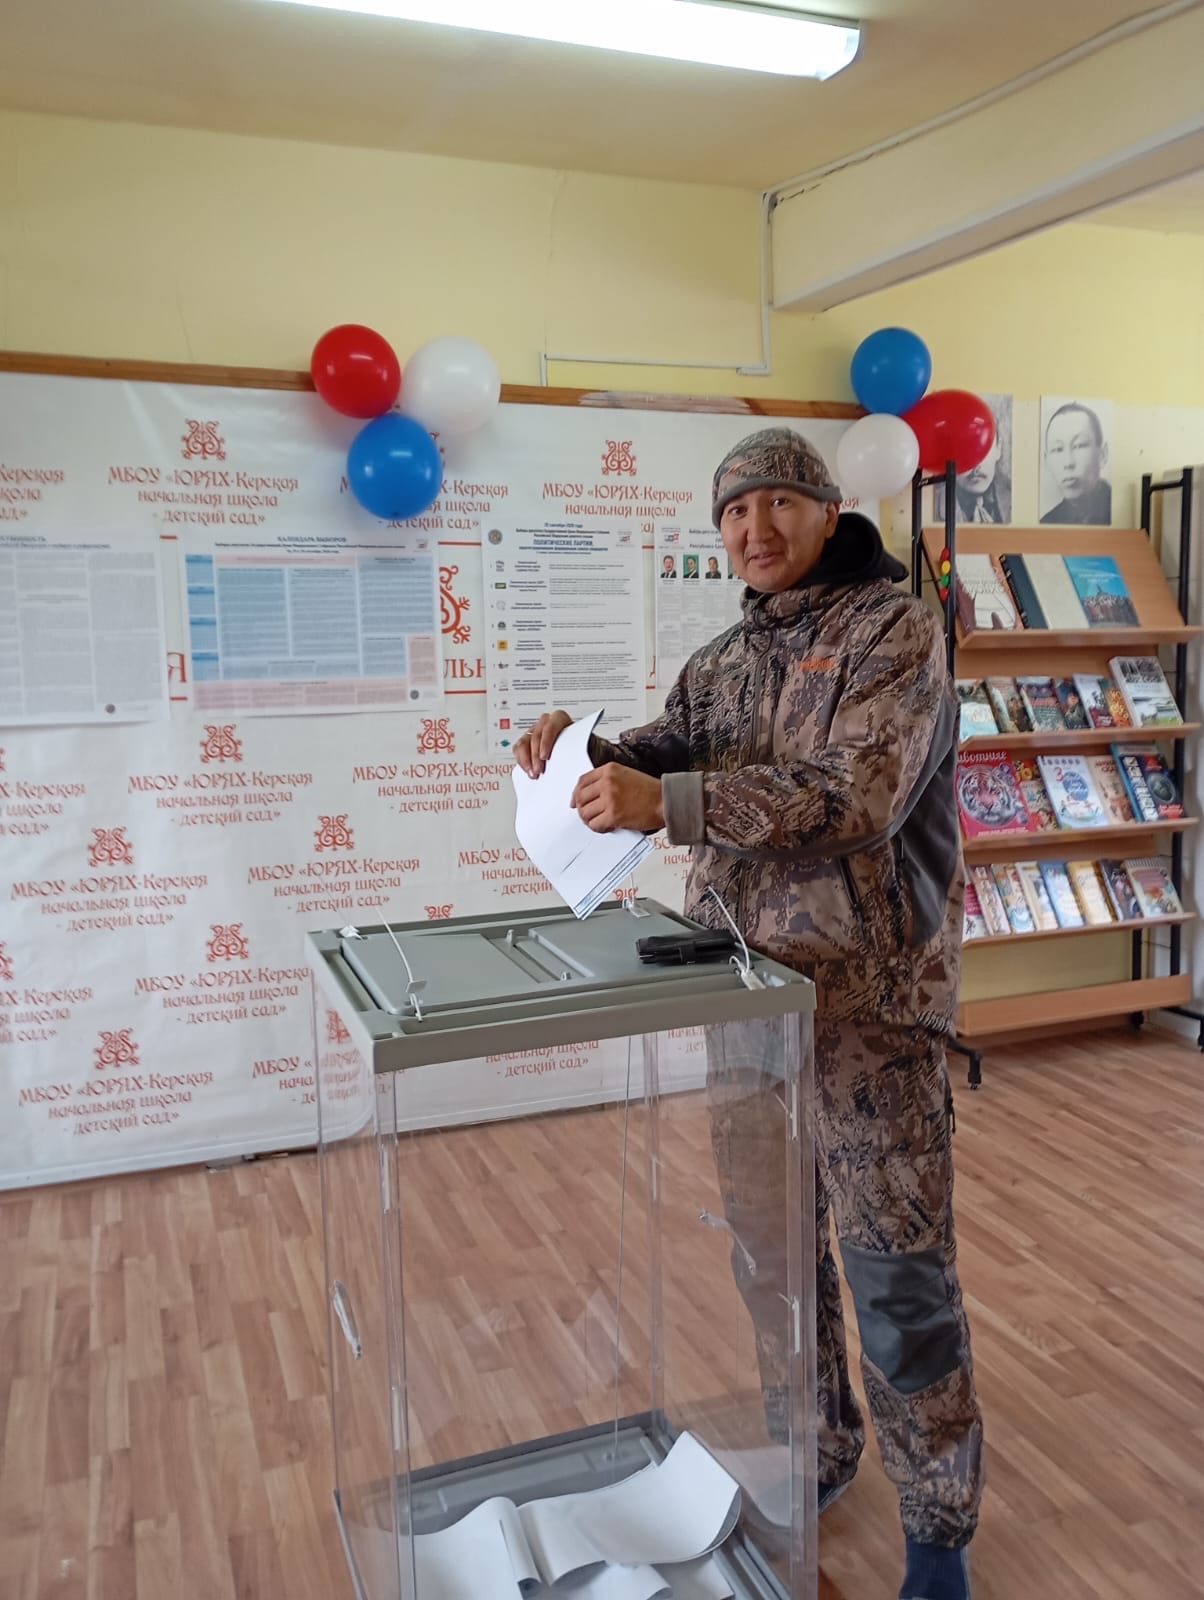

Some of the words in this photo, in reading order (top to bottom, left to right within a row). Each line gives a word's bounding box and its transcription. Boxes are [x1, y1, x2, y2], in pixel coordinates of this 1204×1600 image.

[108, 466, 160, 485] МБОУ
[0, 488, 41, 504] кола
[138, 491, 222, 507] начальная
[227, 494, 278, 508] школа
[542, 483, 584, 499] МБОУ
[587, 484, 693, 504] «ЮРЯХ-Керская
[445, 501, 490, 514] школа
[565, 504, 632, 516] начальная
[636, 506, 676, 519] школа
[163, 511, 225, 526] детский
[229, 515, 265, 525] сад»
[448, 518, 479, 530] сад»
[128, 774, 178, 794] МБОУ
[184, 771, 313, 789] «ЮРЯХ-Керская
[352, 765, 398, 783] МБОУ
[378, 783, 451, 797] начальная
[456, 781, 500, 793] школа
[156, 793, 239, 808] начальная
[244, 791, 293, 806] школа
[398, 797, 453, 814] детский
[458, 799, 488, 809] сад»
[7, 803, 62, 818] школа
[180, 810, 242, 827] детский
[246, 809, 281, 822] сад»
[458, 848, 500, 868] МБОУ
[248, 863, 294, 884] МБОУ
[299, 858, 420, 877] «ЮРЯХ-Керская
[11, 880, 65, 900] МБОУ
[274, 881, 350, 896] начальная
[355, 877, 401, 891] школа
[41, 898, 130, 914] начальная
[134, 894, 187, 909] школа
[296, 895, 353, 913] детский
[357, 894, 390, 906] сад»
[66, 913, 132, 932] детский
[136, 913, 174, 926] сад»
[134, 974, 185, 995] МБОУ
[190, 967, 309, 987] «ЮРЯХ-Керска
[163, 991, 245, 1008] начальная
[249, 985, 298, 1001] школа
[15, 1008, 70, 1025] школа
[186, 1006, 247, 1024] детский
[252, 1005, 286, 1017] сад»
[16, 1029, 57, 1041] сад»
[252, 1056, 299, 1078] МБОУ
[505, 1058, 556, 1077] детский
[559, 1057, 589, 1070] сад»
[19, 1083, 72, 1107] МБОУ
[48, 1098, 135, 1119] начальная
[140, 1092, 192, 1109] школа
[73, 1113, 139, 1136] детский
[142, 1111, 180, 1126] сад»
